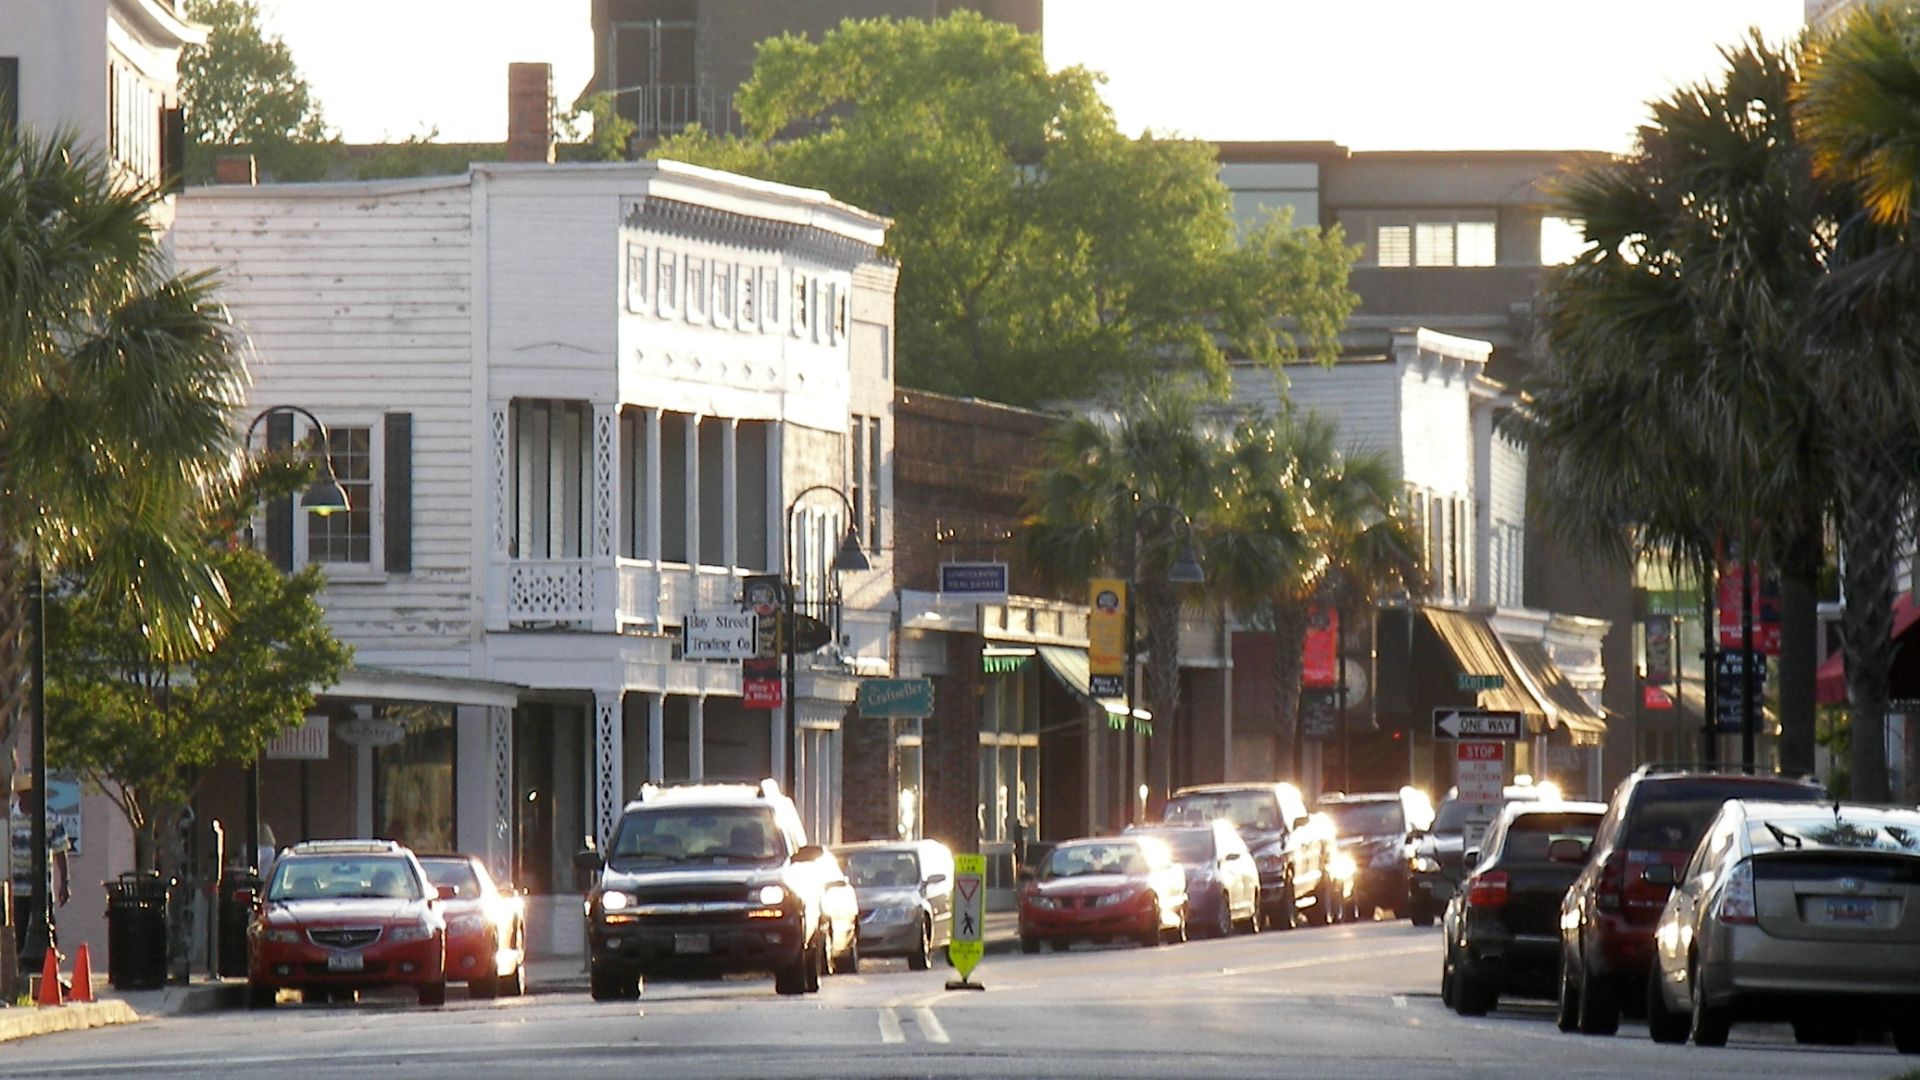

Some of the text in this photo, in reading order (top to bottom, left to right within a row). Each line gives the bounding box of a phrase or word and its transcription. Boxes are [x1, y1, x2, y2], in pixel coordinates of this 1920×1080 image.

[689, 615, 750, 632] Bay Street
[693, 638, 731, 654] Trading
[1460, 719, 1513, 732] ONE WAY
[1466, 746, 1496, 759] STOP
